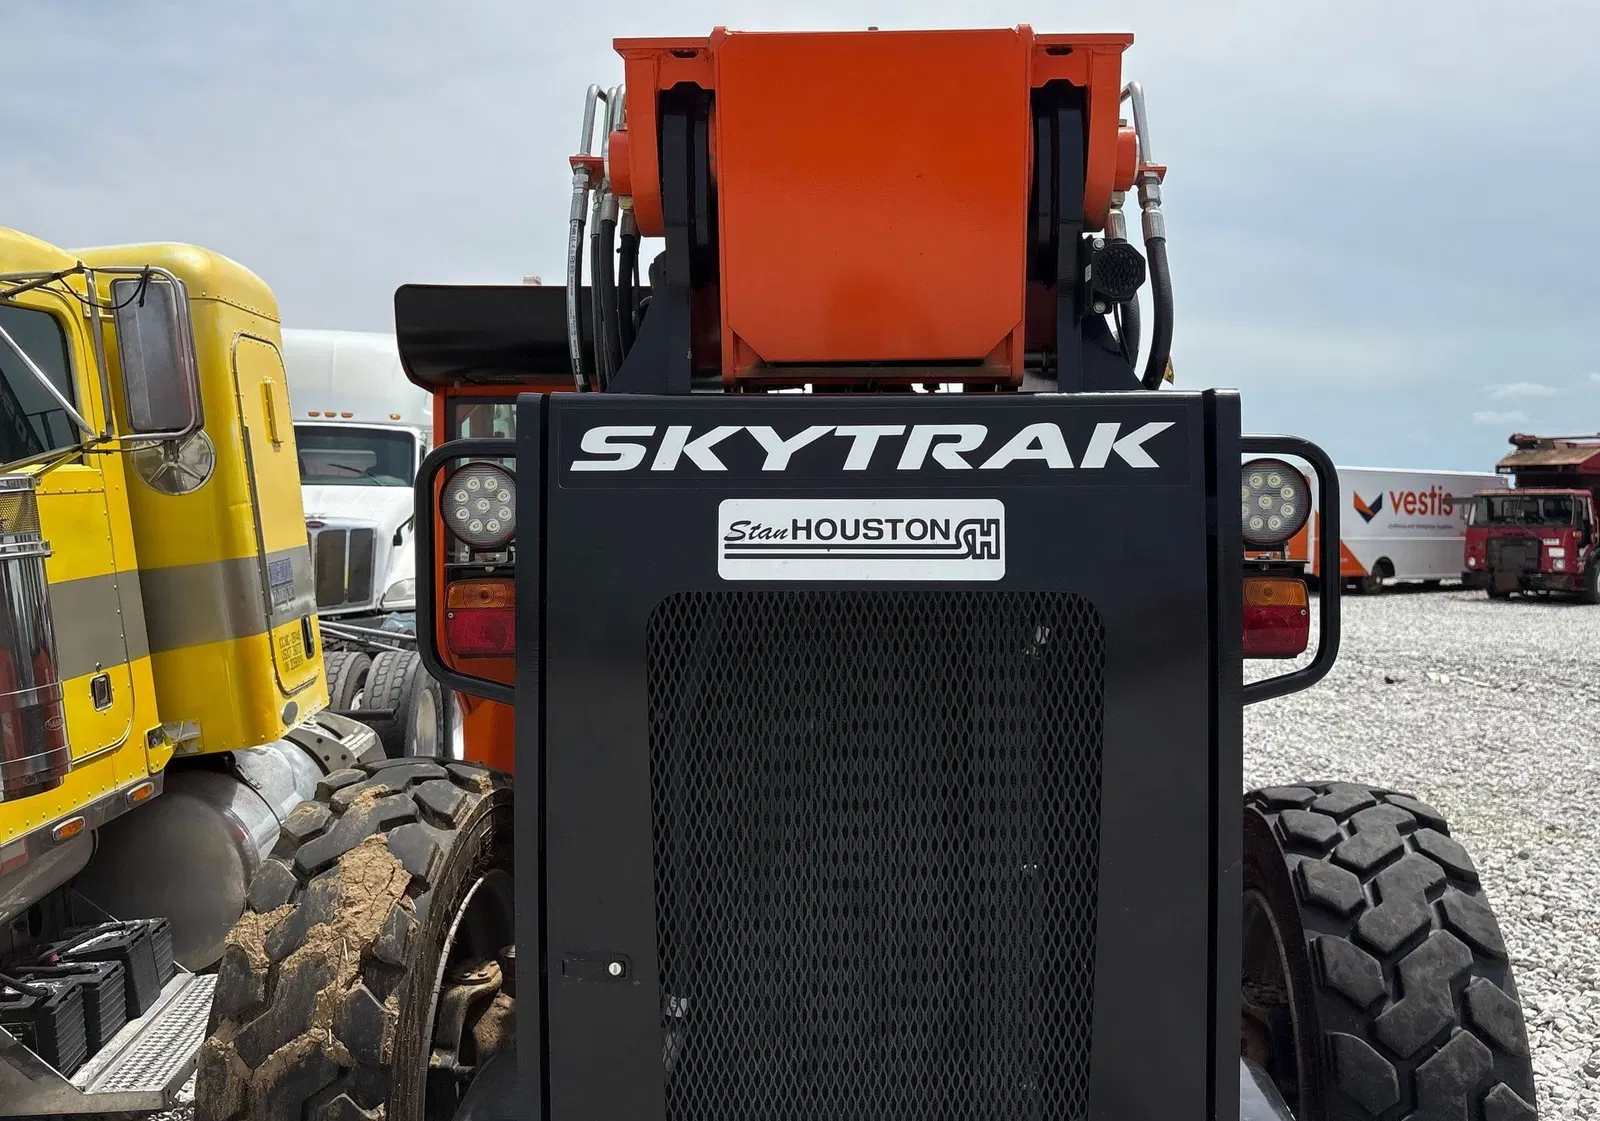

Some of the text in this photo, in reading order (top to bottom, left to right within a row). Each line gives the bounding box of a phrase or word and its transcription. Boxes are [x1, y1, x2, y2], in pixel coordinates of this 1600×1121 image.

[569, 421, 1176, 472] SKYTRAK
[1389, 485, 1454, 516] vestis
[723, 520, 790, 542] Stan
[791, 518, 951, 541] HOUSTON
